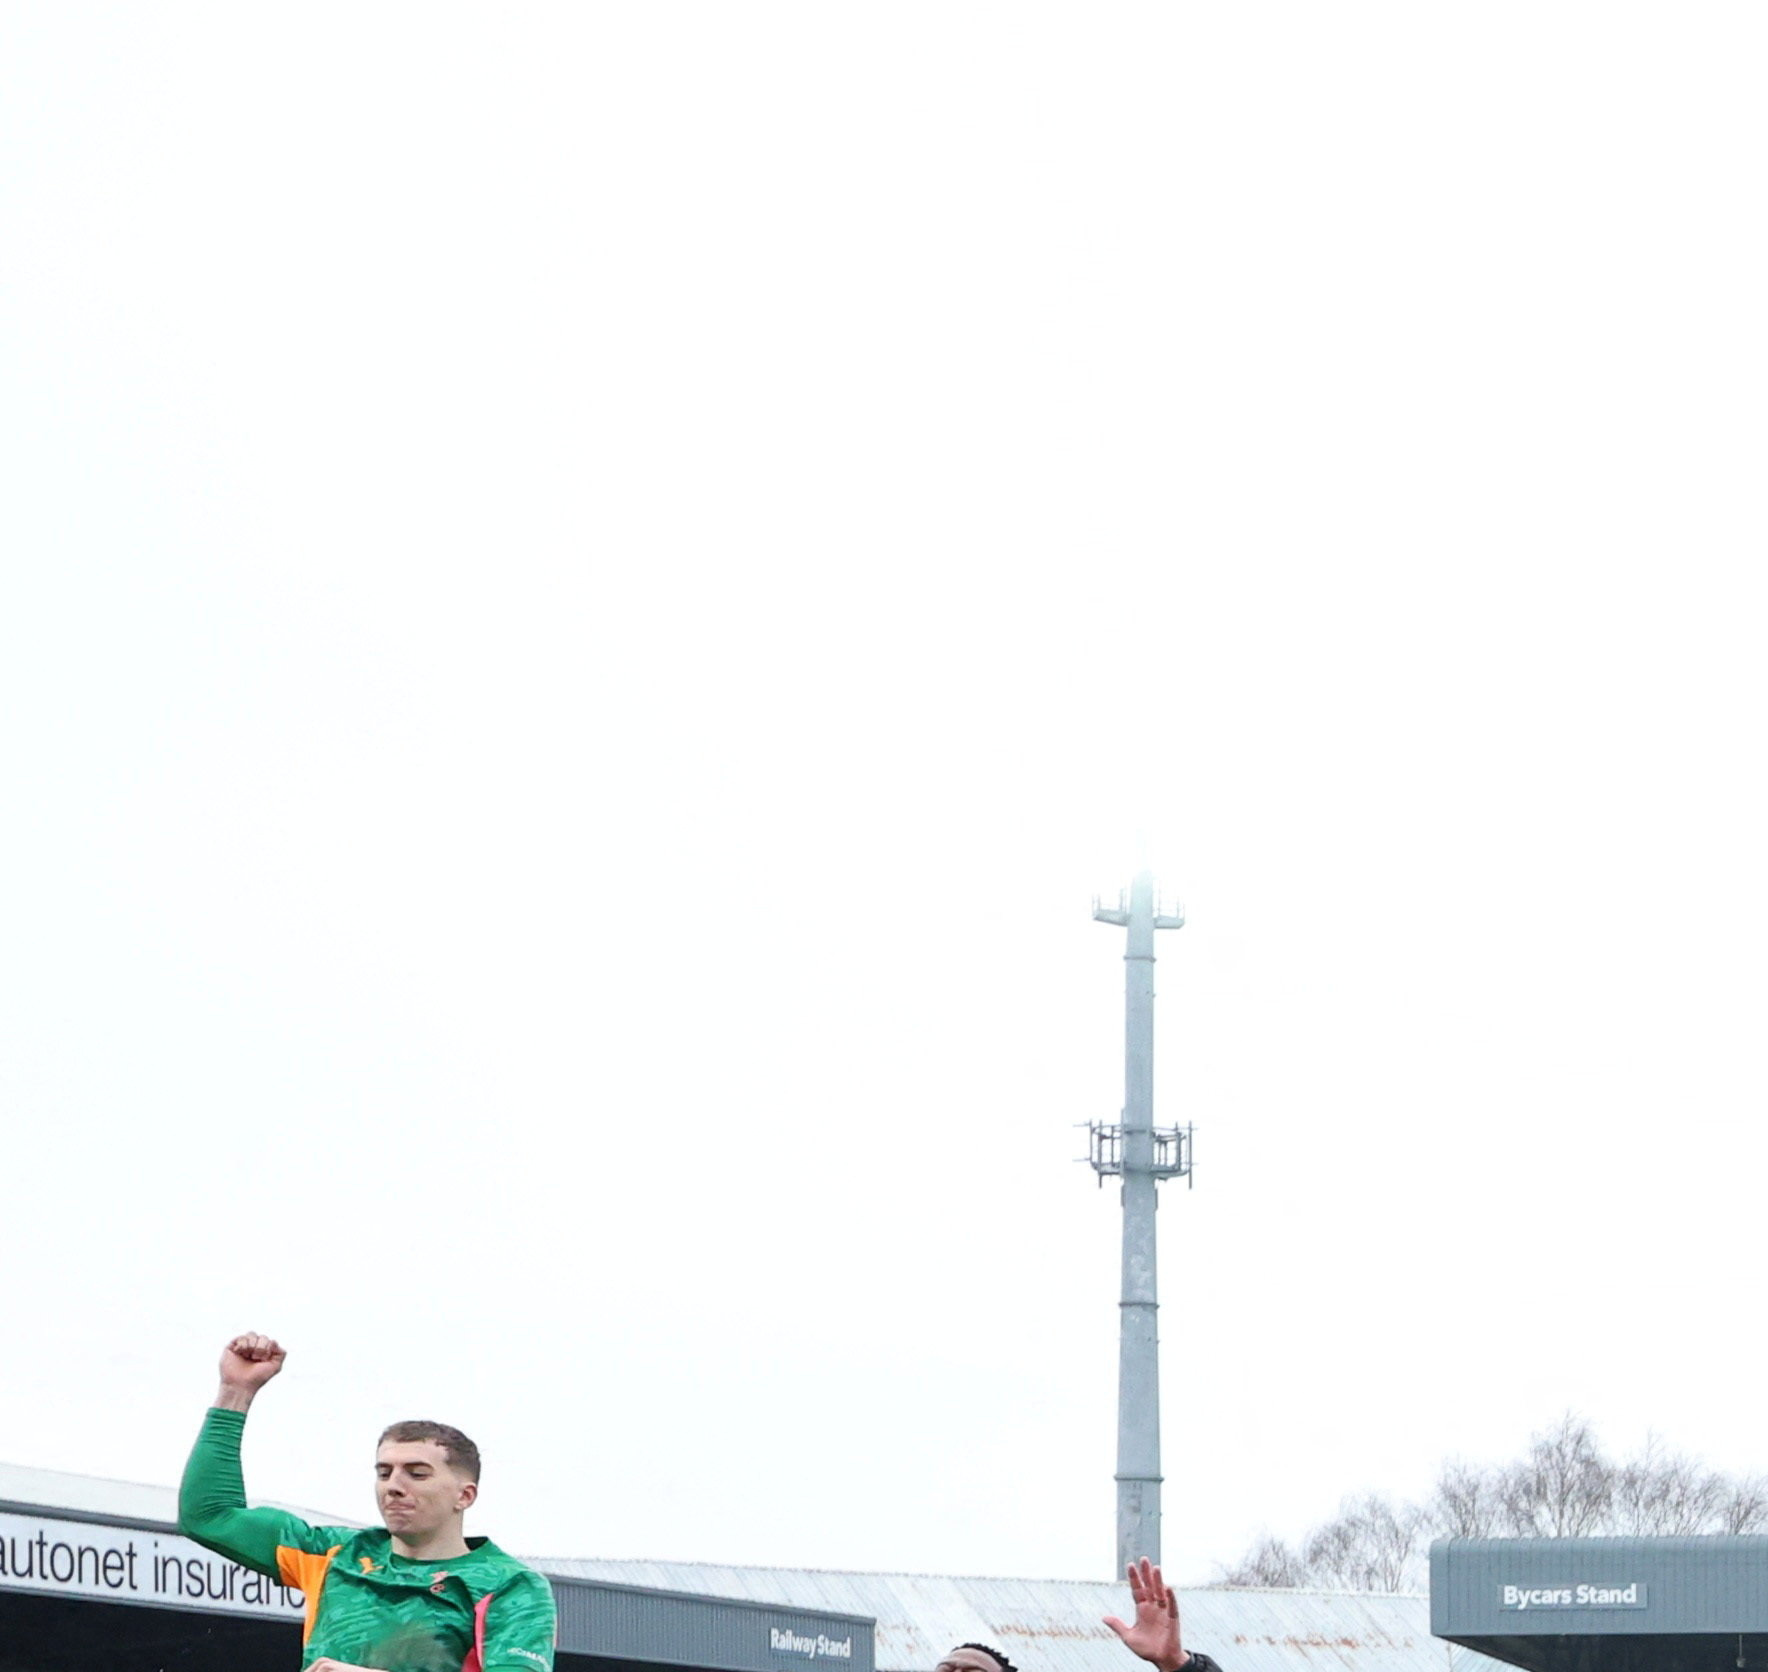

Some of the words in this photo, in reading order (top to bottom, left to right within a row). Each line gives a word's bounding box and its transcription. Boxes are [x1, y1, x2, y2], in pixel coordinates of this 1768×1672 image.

[0, 1530, 137, 1590] utonet
[1503, 1584, 1572, 1610] Bycars
[1576, 1583, 1637, 1604] Stand
[770, 1627, 817, 1659] Railway
[817, 1633, 851, 1658] Stand
